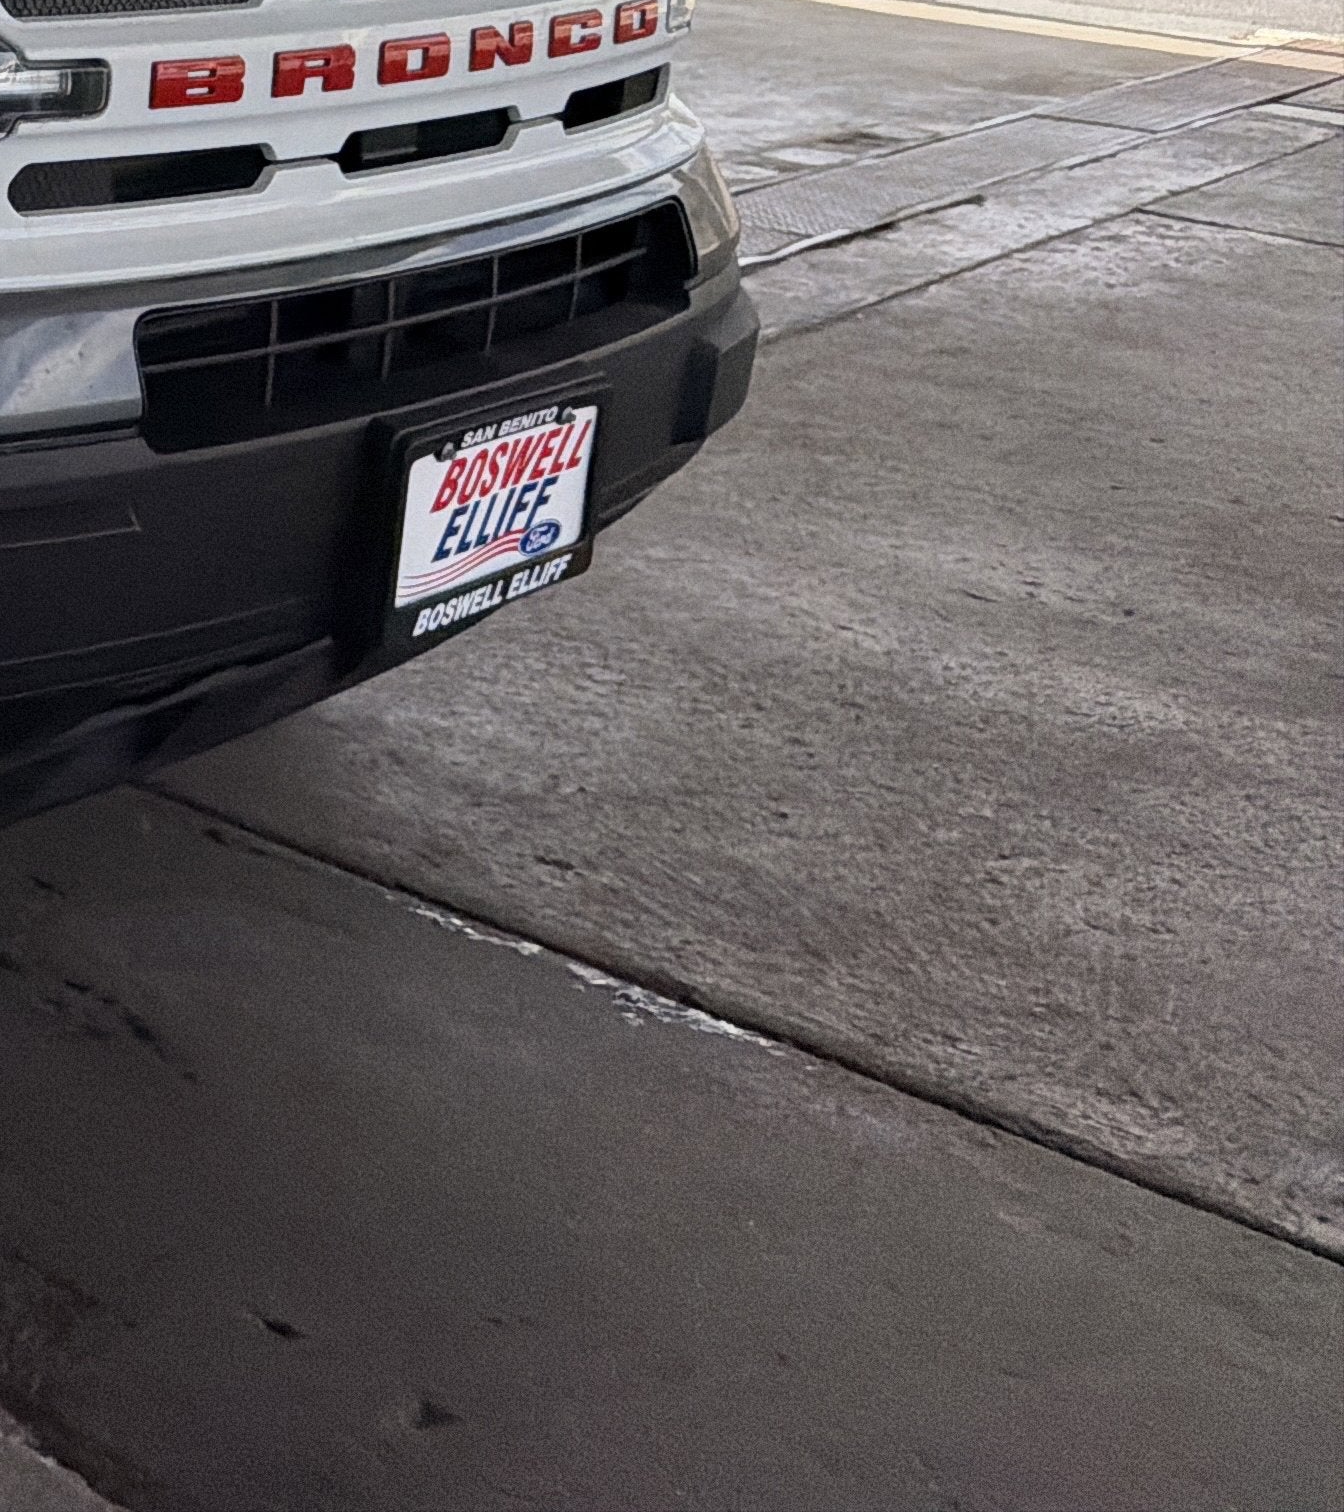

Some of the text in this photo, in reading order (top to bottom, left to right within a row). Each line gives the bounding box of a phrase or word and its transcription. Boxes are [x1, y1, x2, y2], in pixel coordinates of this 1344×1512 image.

[430, 419, 592, 513] BOSWELL
[460, 406, 559, 448] SAN BENITO
[431, 475, 560, 563] ELLIFF
[522, 522, 559, 554] Ford
[412, 553, 573, 637] BOSWELL ELLIFF
